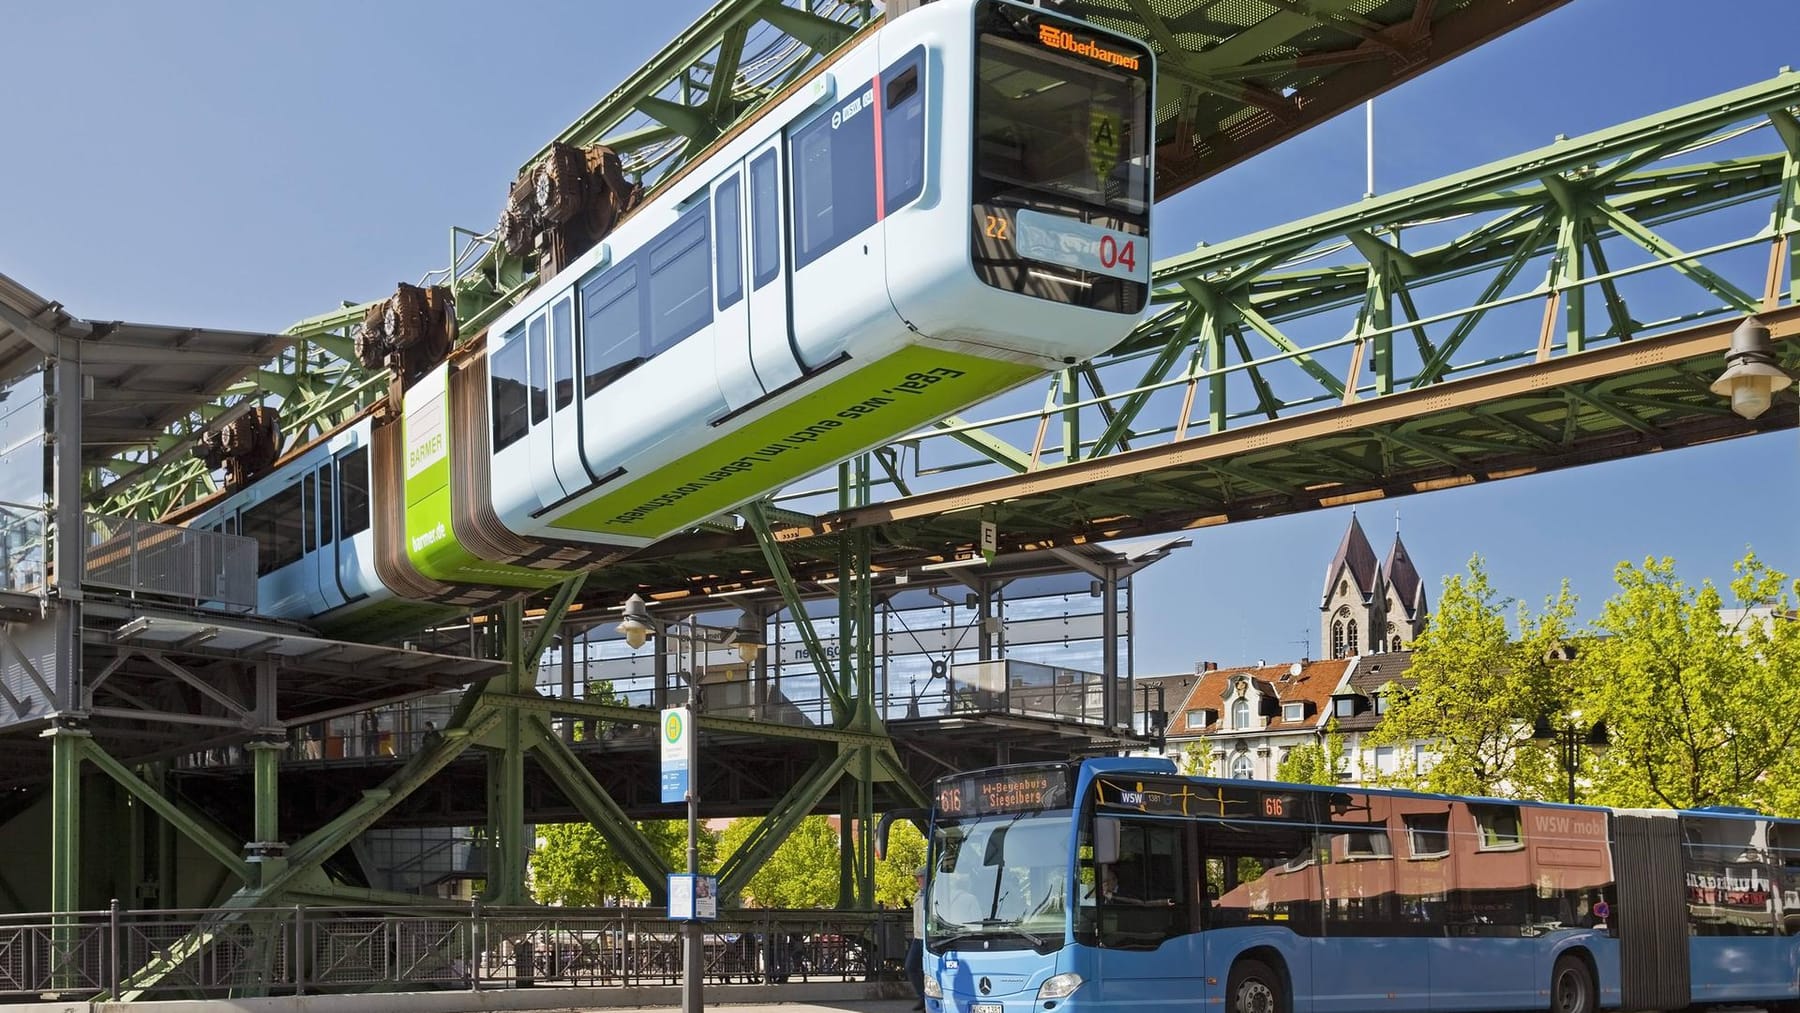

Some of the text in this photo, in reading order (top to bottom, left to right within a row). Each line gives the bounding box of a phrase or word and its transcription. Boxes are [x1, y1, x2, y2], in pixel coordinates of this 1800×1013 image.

[1060, 31, 1139, 70] Oberbarmen
[1094, 118, 1112, 147] A
[985, 215, 1007, 241] 22
[1099, 234, 1136, 273] 04
[882, 367, 966, 394] Egal,
[836, 397, 896, 420] was
[783, 419, 843, 443] euch
[410, 433, 443, 468] BARMER
[754, 443, 800, 456] im
[699, 456, 771, 482] Leben
[412, 522, 447, 552] barmer.de
[985, 528, 993, 544] E
[940, 789, 961, 812] 616
[990, 791, 1041, 807] Siegelberg
[1122, 792, 1161, 804] WSW 1381
[1265, 798, 1283, 816] 616
[1535, 815, 1606, 835] WSW mobi
